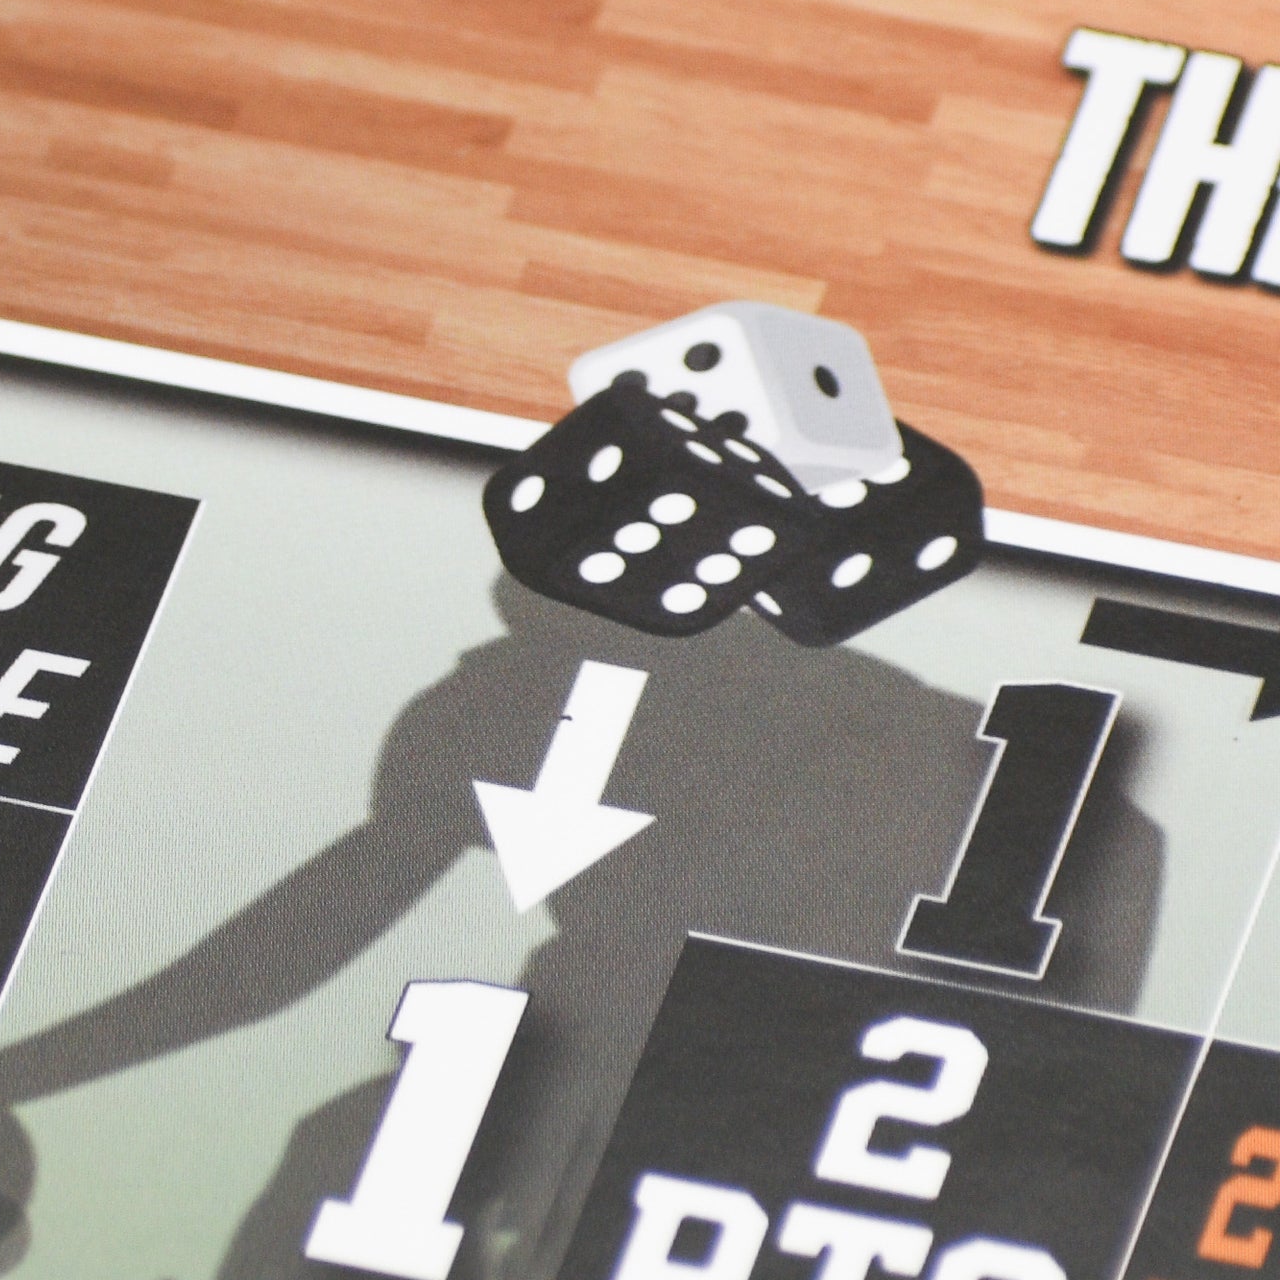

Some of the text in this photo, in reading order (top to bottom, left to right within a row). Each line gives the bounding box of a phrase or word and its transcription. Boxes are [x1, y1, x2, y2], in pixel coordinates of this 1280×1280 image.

[1030, 26, 1280, 286] TH
[897, 681, 1122, 979] 1
[815, 1017, 988, 1199] 2
